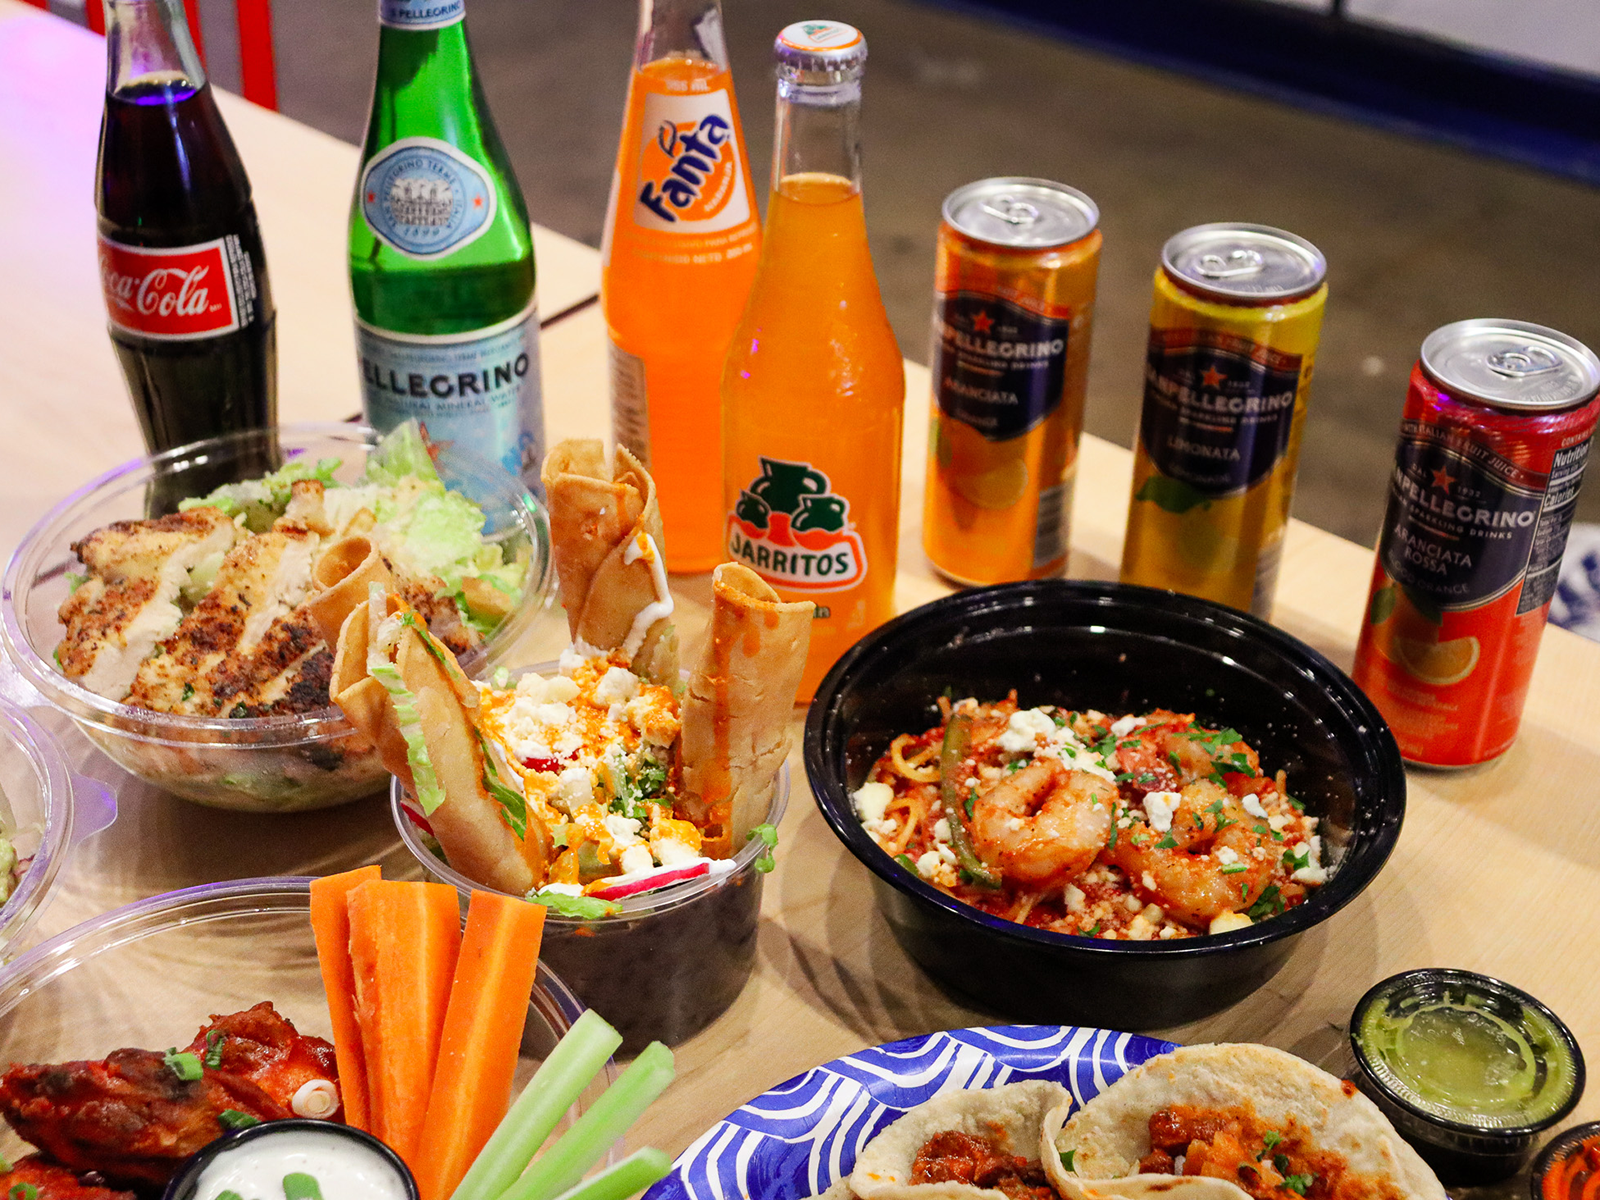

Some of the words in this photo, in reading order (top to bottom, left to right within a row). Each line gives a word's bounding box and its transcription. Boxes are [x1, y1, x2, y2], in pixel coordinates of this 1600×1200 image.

[640, 115, 729, 222] Fanta
[361, 352, 529, 399] ELLEGRINO
[1488, 455, 1519, 479] JUICE
[1553, 444, 1589, 468] Nutrition
[1394, 523, 1472, 568] ARANCIATA
[1470, 529, 1512, 540] DRINKS
[730, 533, 849, 577] JARRITOS
[1404, 545, 1447, 576] ROSSA
